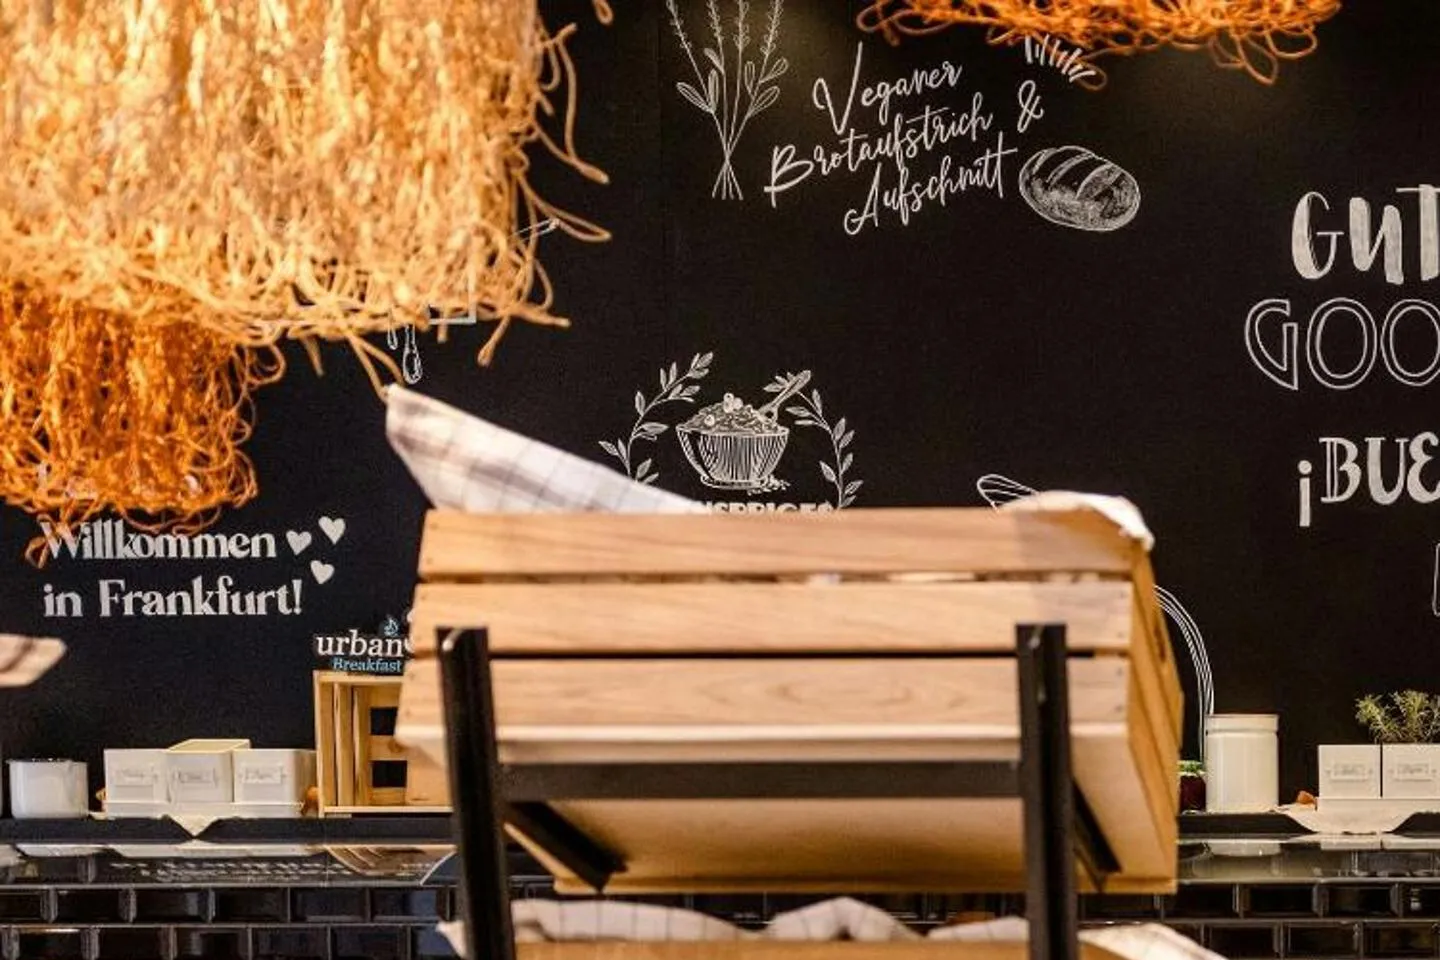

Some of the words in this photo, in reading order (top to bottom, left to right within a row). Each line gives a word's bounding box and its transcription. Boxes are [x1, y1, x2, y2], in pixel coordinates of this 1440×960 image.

[813, 41, 962, 134] Veganer
[764, 91, 993, 208] Brotaufstrich
[1017, 80, 1044, 133] &
[844, 131, 1018, 235] Aufschnitt
[40, 518, 277, 559] Willkommen
[43, 583, 84, 617] in
[98, 575, 302, 617] Frankfurt!
[316, 629, 404, 658] urban
[332, 658, 402, 672] Breakfast
